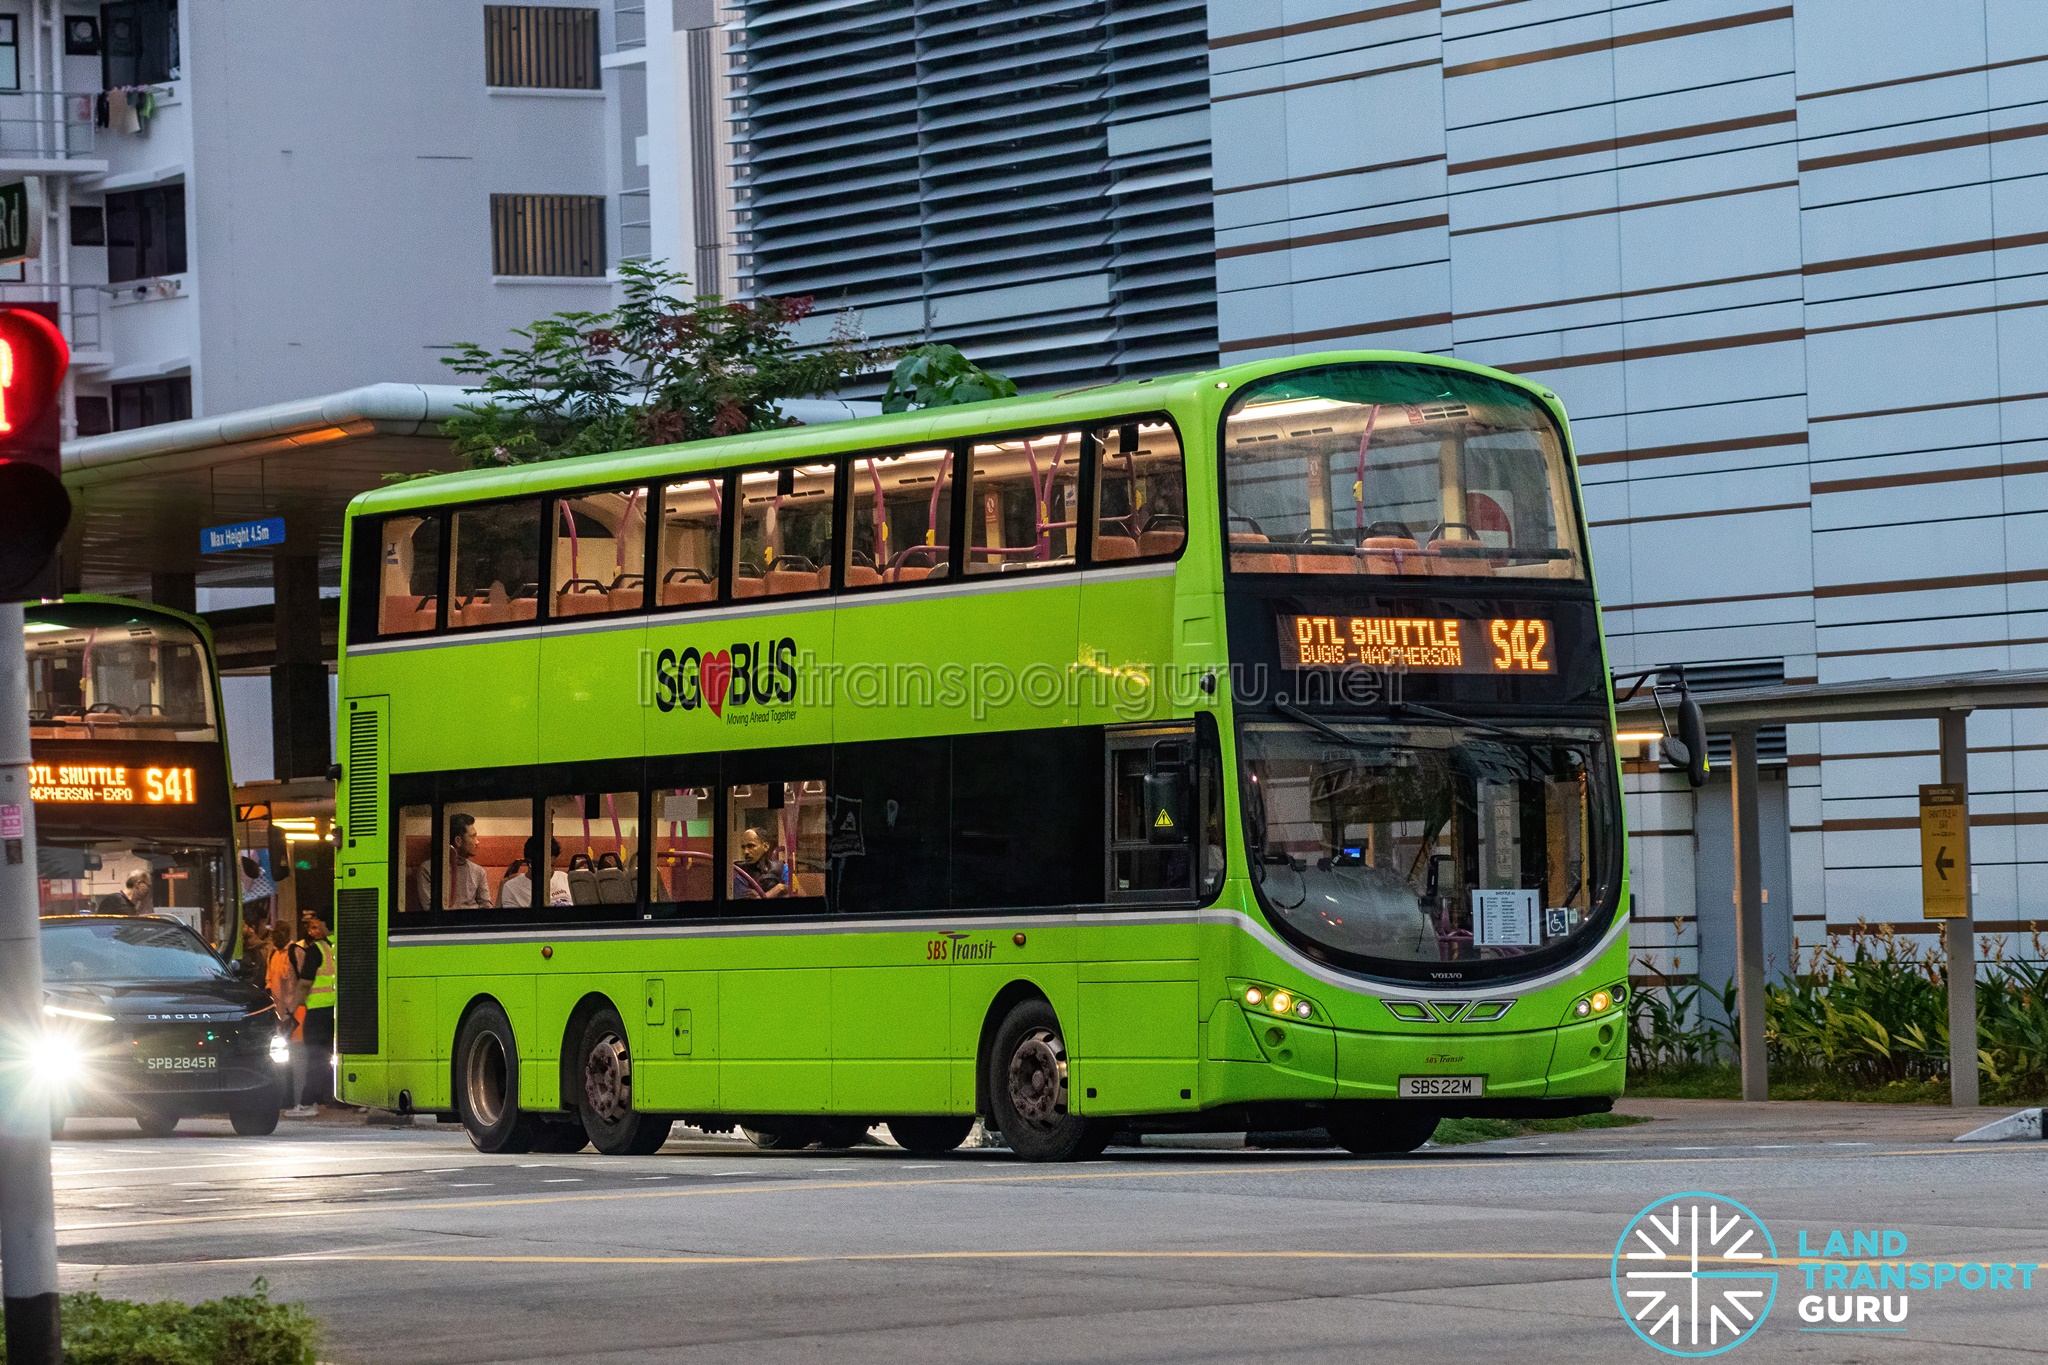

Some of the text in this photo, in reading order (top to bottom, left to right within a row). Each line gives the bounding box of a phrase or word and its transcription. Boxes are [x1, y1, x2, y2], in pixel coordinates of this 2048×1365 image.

[210, 525, 270, 548] Max Height 4.5m
[1296, 618, 1460, 646] DTL SHUTTLE
[1491, 619, 1550, 670] S42
[727, 709, 798, 727] Moving Ahead Together
[59, 766, 126, 786] SHUTTLE
[146, 768, 193, 802] S41
[927, 934, 997, 963] SBS Transit
[147, 1056, 217, 1070] SPB2845R
[1411, 1080, 1472, 1094] SBS22M
